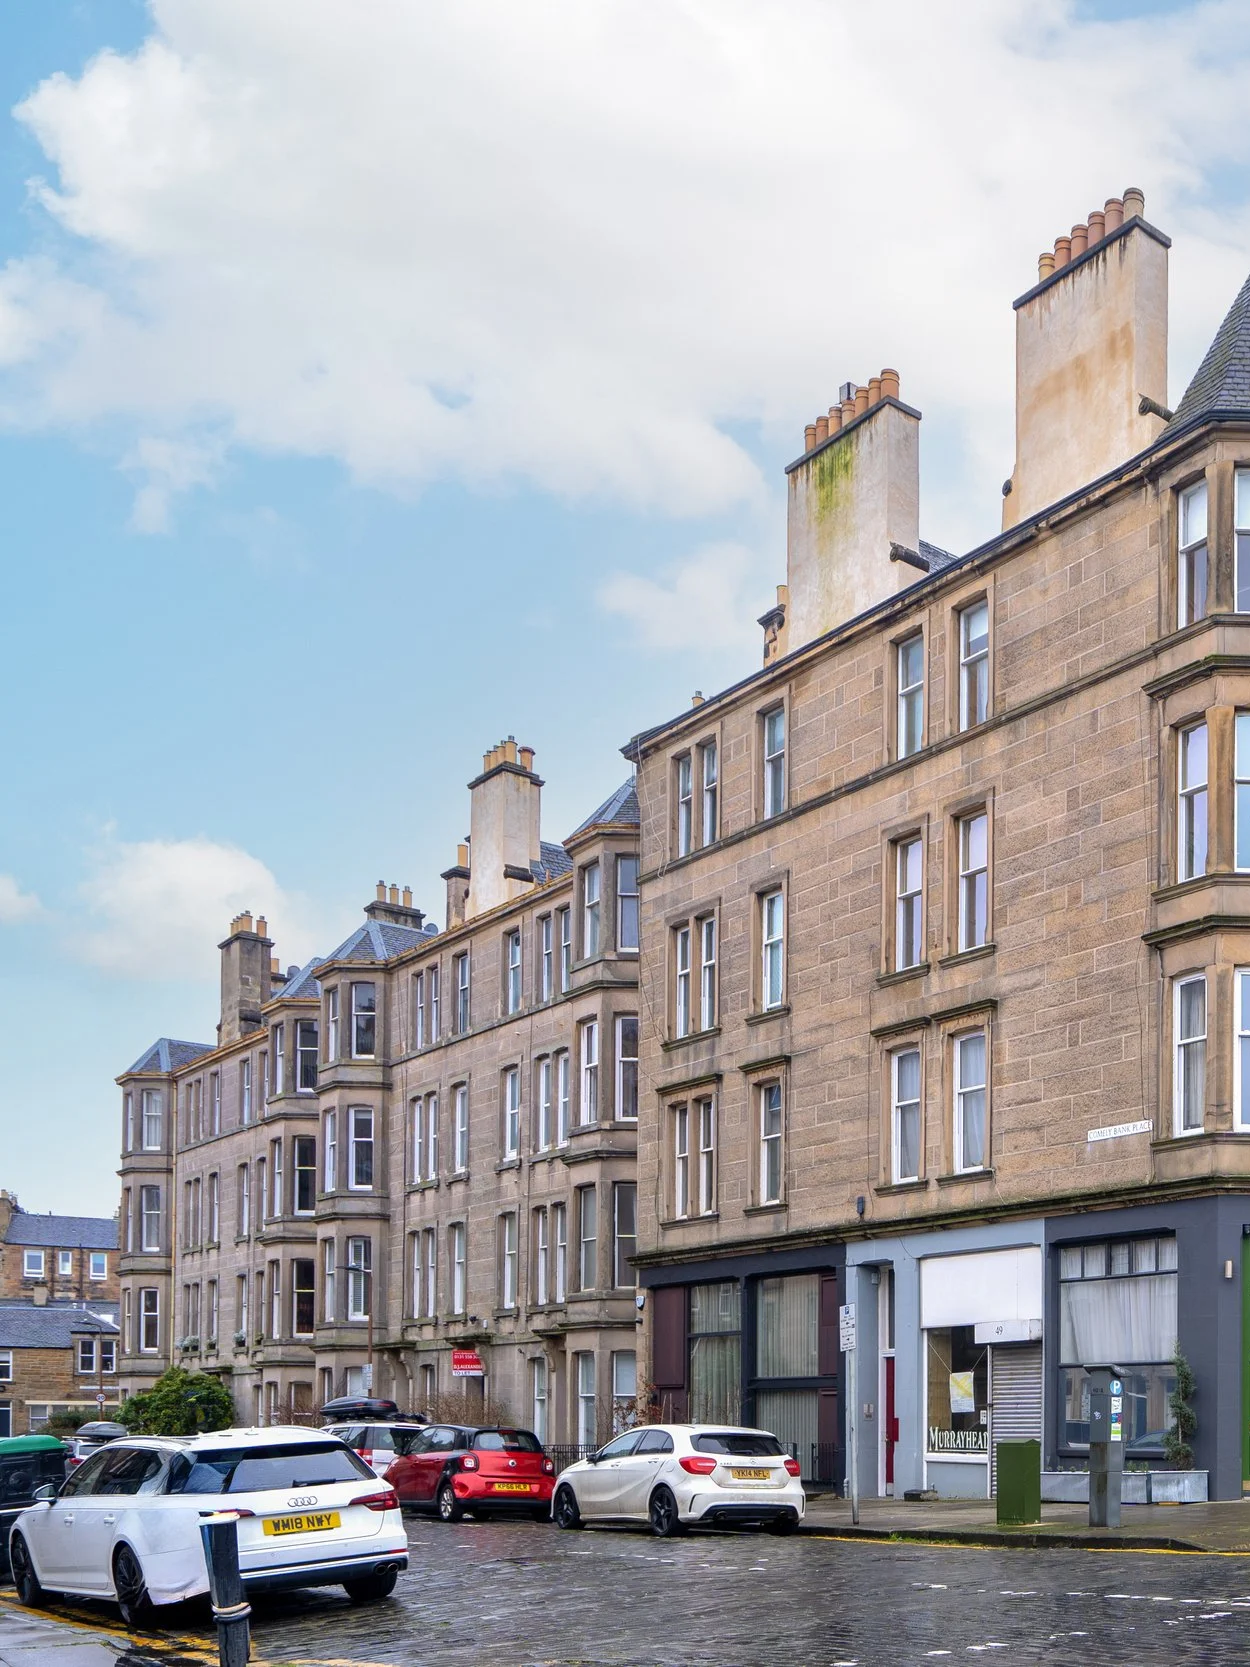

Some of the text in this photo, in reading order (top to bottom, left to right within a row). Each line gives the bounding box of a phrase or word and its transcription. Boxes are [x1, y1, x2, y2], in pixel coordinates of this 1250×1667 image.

[1088, 1121, 1151, 1140] COMELY BANK PLACE
[995, 1326, 1004, 1335] 49
[929, 1426, 988, 1451] MURRAYHEAD
[736, 1469, 752, 1477] YK14
[272, 1514, 332, 1531] WM18 NWY
